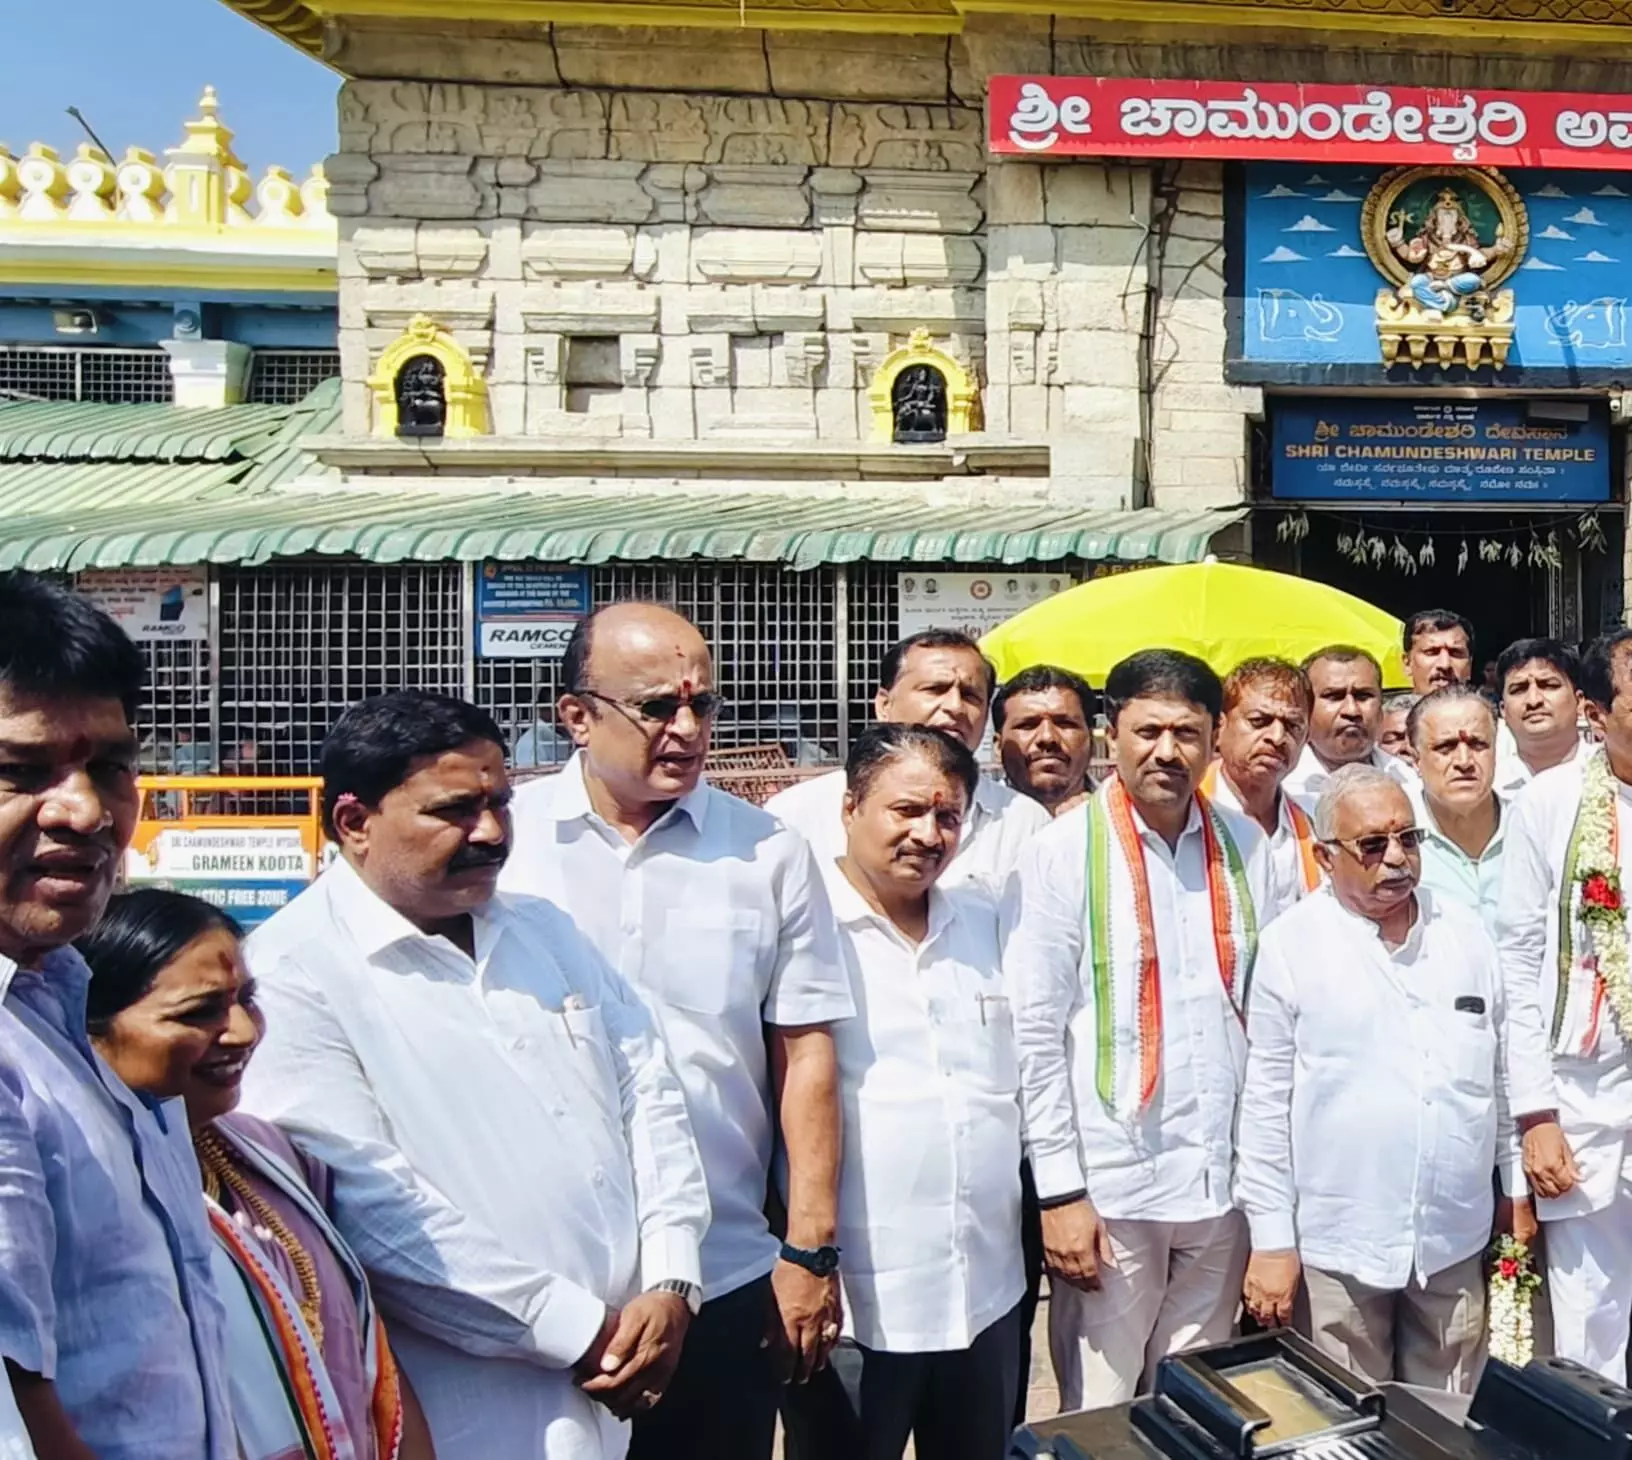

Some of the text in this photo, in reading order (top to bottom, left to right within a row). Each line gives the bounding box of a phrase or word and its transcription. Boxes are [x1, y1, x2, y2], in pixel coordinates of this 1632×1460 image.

[1008, 82, 1092, 150] ಶ್ರೀ
[1119, 88, 1528, 161] ಚಾಮುಂಡೇಶ್ವರಿ
[1314, 420, 1341, 442] ಶ್ರೀ
[1285, 444, 1595, 462] SHRI CHAMUNDESHWARI TEMPLE
[489, 628, 574, 642] RAMCO
[529, 642, 567, 650] CEMEN
[192, 855, 304, 871] GRAMEEN KOOTA
